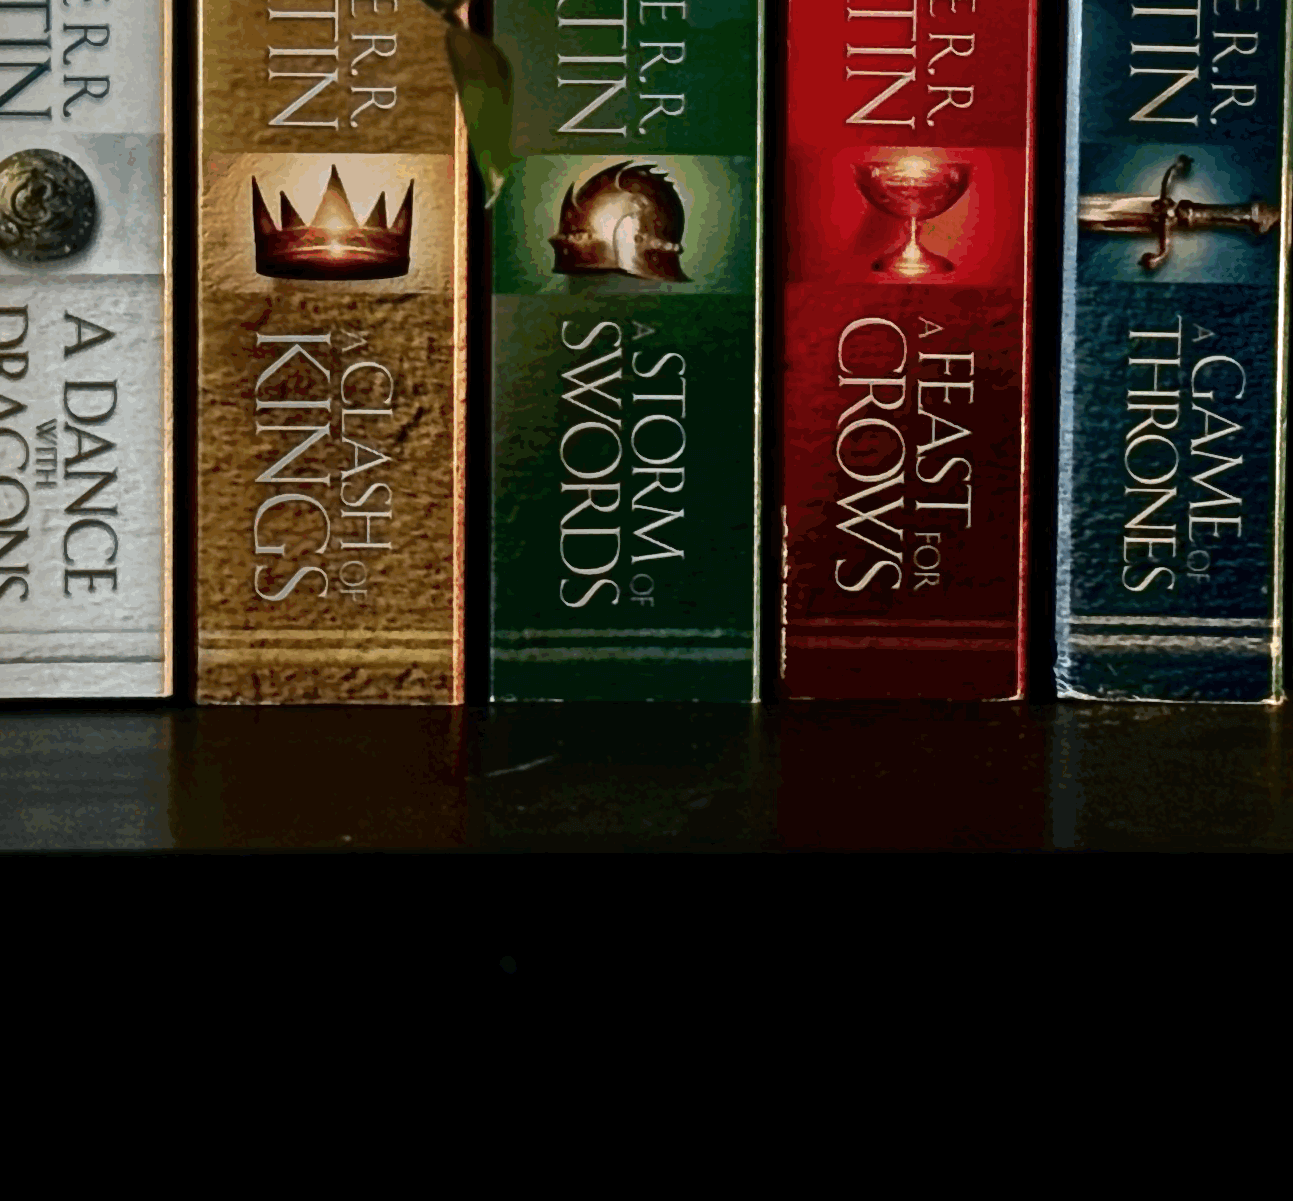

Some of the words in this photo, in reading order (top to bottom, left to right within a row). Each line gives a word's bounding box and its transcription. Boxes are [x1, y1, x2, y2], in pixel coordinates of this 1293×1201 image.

[63, 309, 117, 360] A
[630, 319, 657, 342] A
[917, 315, 945, 340] A
[1192, 322, 1217, 344] A
[34, 417, 58, 491] WITH
[62, 378, 120, 599] DANCE
[252, 330, 333, 603] KINGS
[339, 360, 396, 551] CLASH
[558, 319, 624, 610] SWORDS
[630, 350, 688, 565] STORM
[833, 316, 908, 593] CROWS
[914, 350, 976, 530] FEAST
[1120, 314, 1183, 593] THRONES
[1188, 354, 1247, 544] GAME
[337, 559, 369, 603] OF
[629, 572, 656, 608] OF
[912, 531, 942, 593] FOR
[1186, 548, 1212, 585] OF
